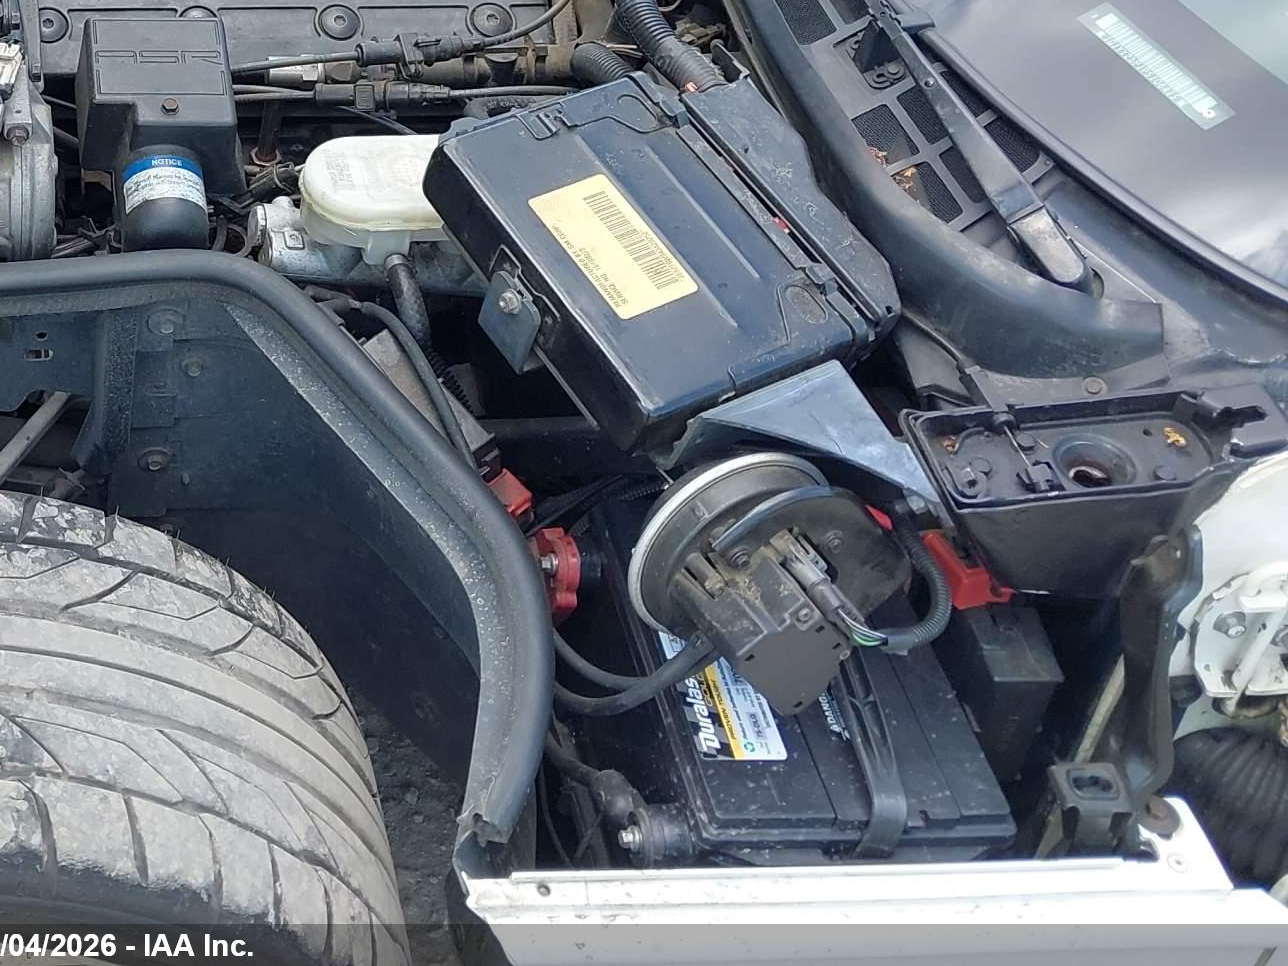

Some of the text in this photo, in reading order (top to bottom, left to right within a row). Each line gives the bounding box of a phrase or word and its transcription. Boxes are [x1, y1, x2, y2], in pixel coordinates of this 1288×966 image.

[94, 50, 225, 66] ASR
[151, 158, 183, 167] NOTICE
[711, 679, 724, 706] TOUGH
[818, 693, 836, 724] DANG
[721, 707, 737, 740] PROVEN
